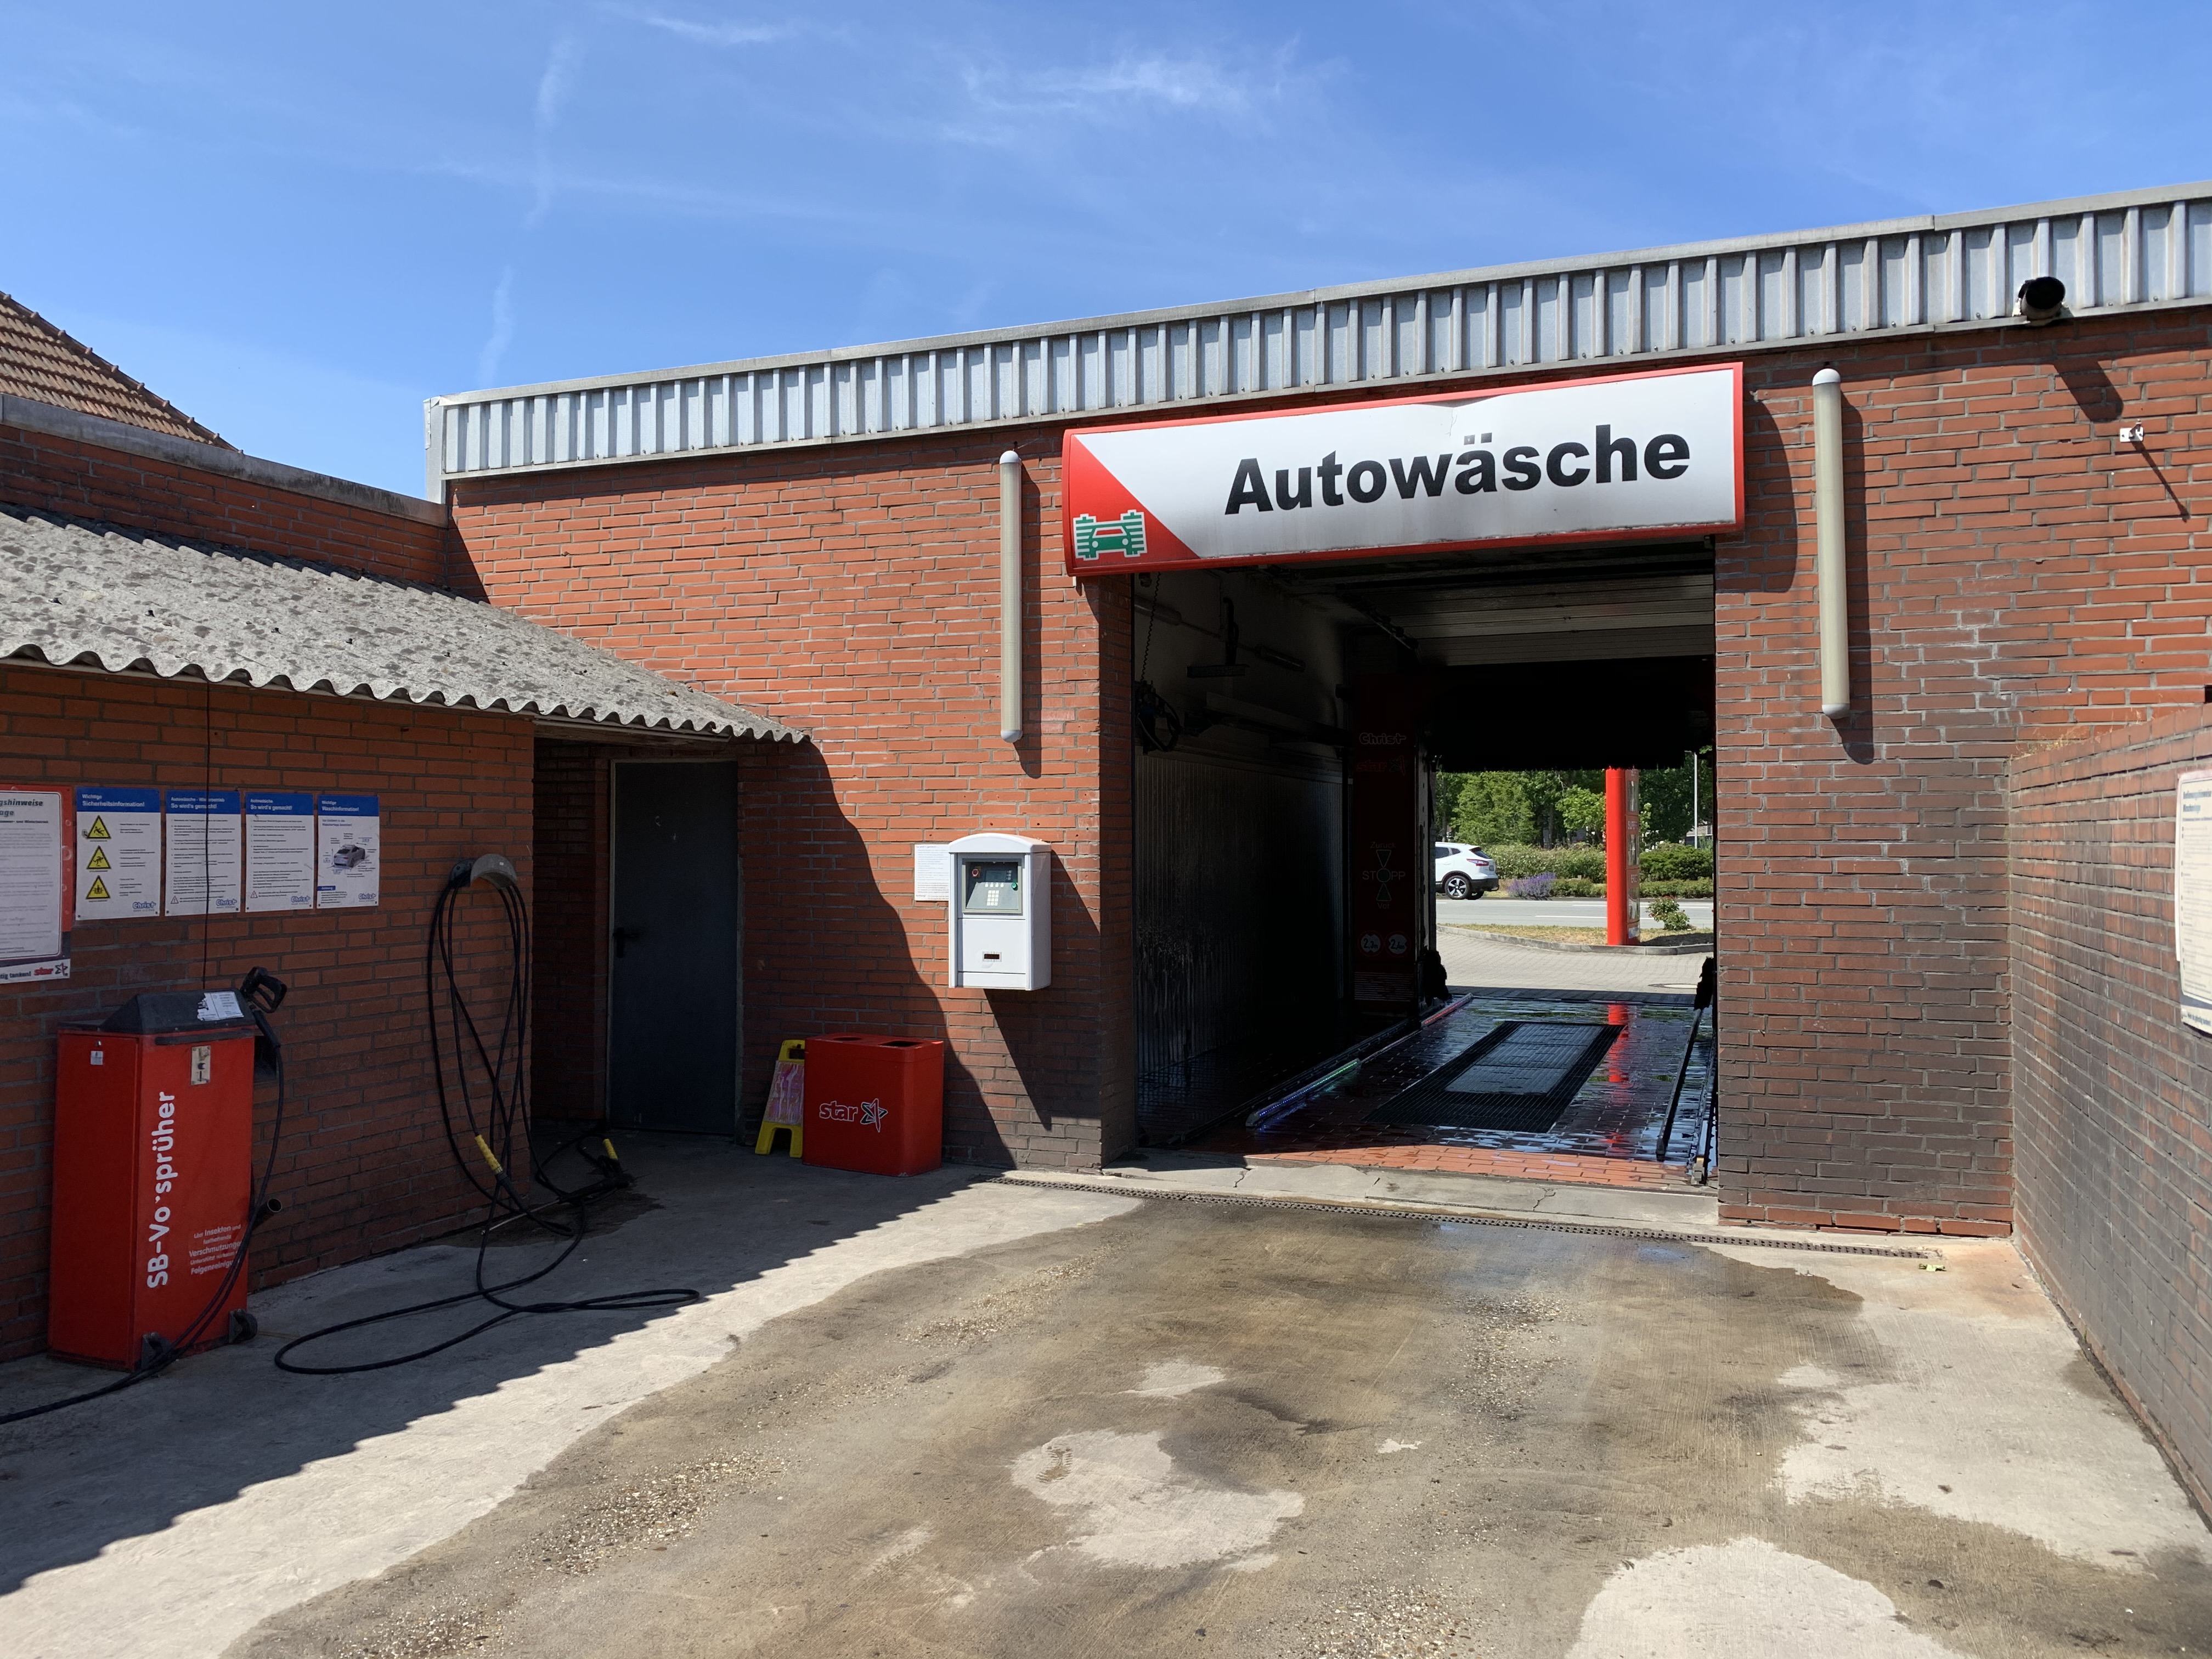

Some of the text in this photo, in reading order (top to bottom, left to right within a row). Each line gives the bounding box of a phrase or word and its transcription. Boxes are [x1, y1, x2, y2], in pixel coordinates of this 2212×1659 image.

[1224, 425, 1690, 516] Autowäsche
[1359, 732, 1407, 745] Christ
[1362, 868, 1406, 883] STOPP
[132, 901, 156, 909] Christ
[33, 967, 54, 976] star
[819, 1101, 858, 1122] star
[146, 1091, 178, 1289] SB-Vosprüher
[205, 1226, 231, 1236] Insekten
